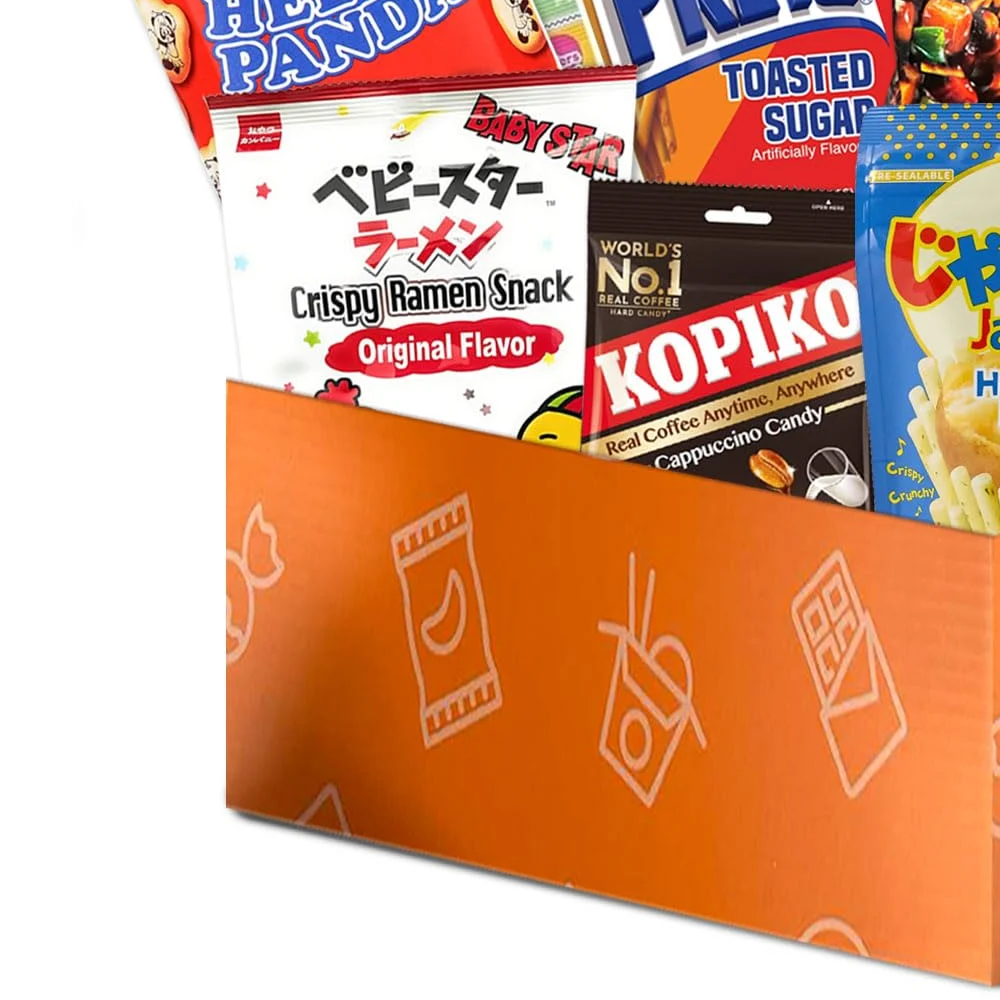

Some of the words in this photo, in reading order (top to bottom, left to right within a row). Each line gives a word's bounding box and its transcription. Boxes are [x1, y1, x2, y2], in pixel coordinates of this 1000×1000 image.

[722, 52, 873, 100] TOASTED
[464, 93, 548, 152] BABY
[545, 122, 625, 178] STAR
[752, 144, 816, 162] Artificially
[313, 157, 543, 215] ベビースター
[354, 217, 503, 270] ラーメン
[600, 240, 682, 258] WORLD'S
[290, 284, 380, 325] Crispy
[389, 276, 482, 313] Ramen
[490, 270, 575, 305] Snack
[598, 258, 682, 296] No.1
[599, 295, 629, 305] REAL
[633, 296, 680, 307] COFFEE
[610, 309, 634, 317] HARD
[358, 332, 452, 366] Original
[460, 332, 537, 358] Flavor
[594, 276, 861, 416] KOPIKO
[606, 436, 641, 456] Real
[643, 417, 700, 446] Coffee
[703, 394, 774, 426] Anytime,
[775, 364, 856, 402] Anywhere
[655, 428, 762, 471] Cappuccino
[764, 406, 824, 437] Candy
[886, 462, 925, 485] Crispy
[888, 486, 936, 506] Crunchy
